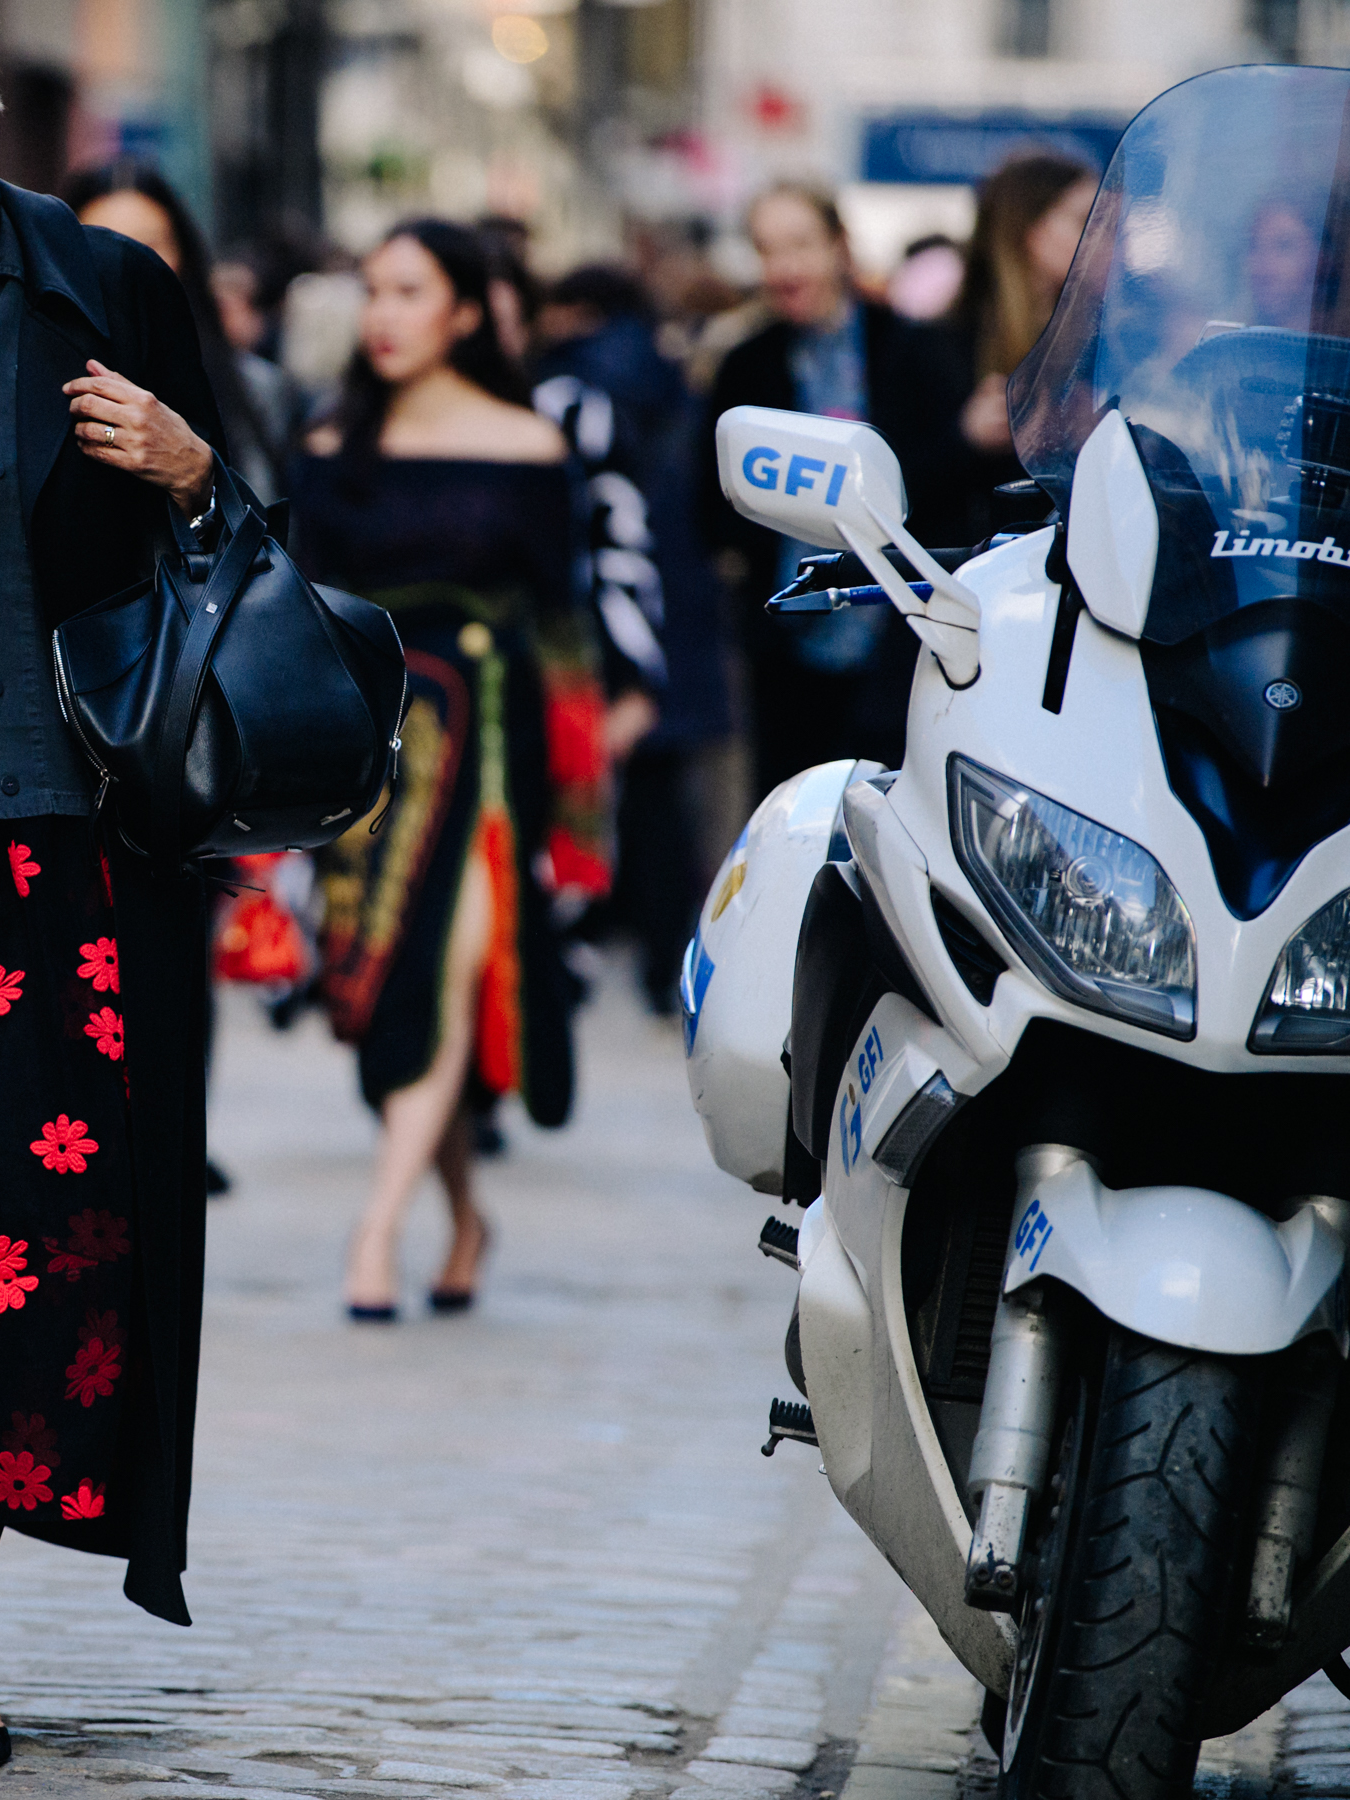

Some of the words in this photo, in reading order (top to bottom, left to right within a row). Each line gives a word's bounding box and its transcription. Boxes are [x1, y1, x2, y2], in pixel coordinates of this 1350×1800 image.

[741, 446, 848, 507] GFI
[1210, 530, 1350, 567] Limob
[858, 1025, 884, 1095] GFI
[1015, 1199, 1054, 1273] GFI
